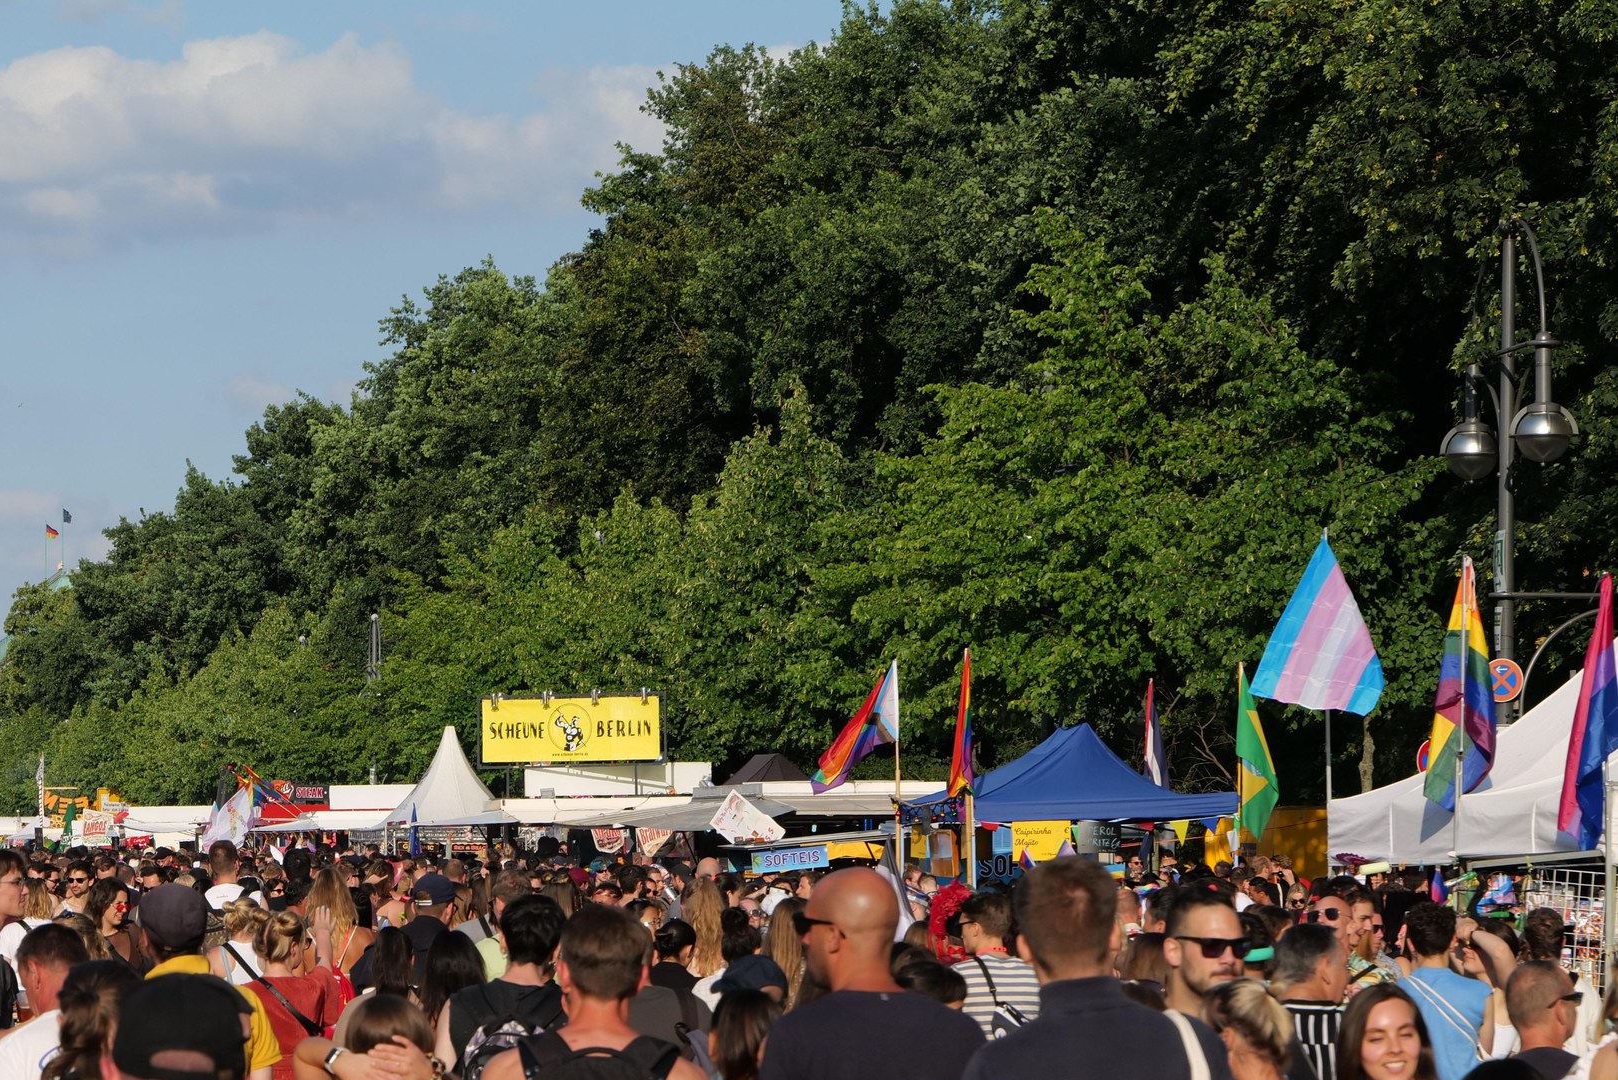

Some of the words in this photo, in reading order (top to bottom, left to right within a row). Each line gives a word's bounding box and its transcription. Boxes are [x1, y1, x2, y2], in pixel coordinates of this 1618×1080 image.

[489, 722, 545, 740] SCHEUNE
[596, 719, 652, 738] BERLIN
[295, 786, 324, 799] STEAK
[764, 850, 820, 867] SOFTEIS
